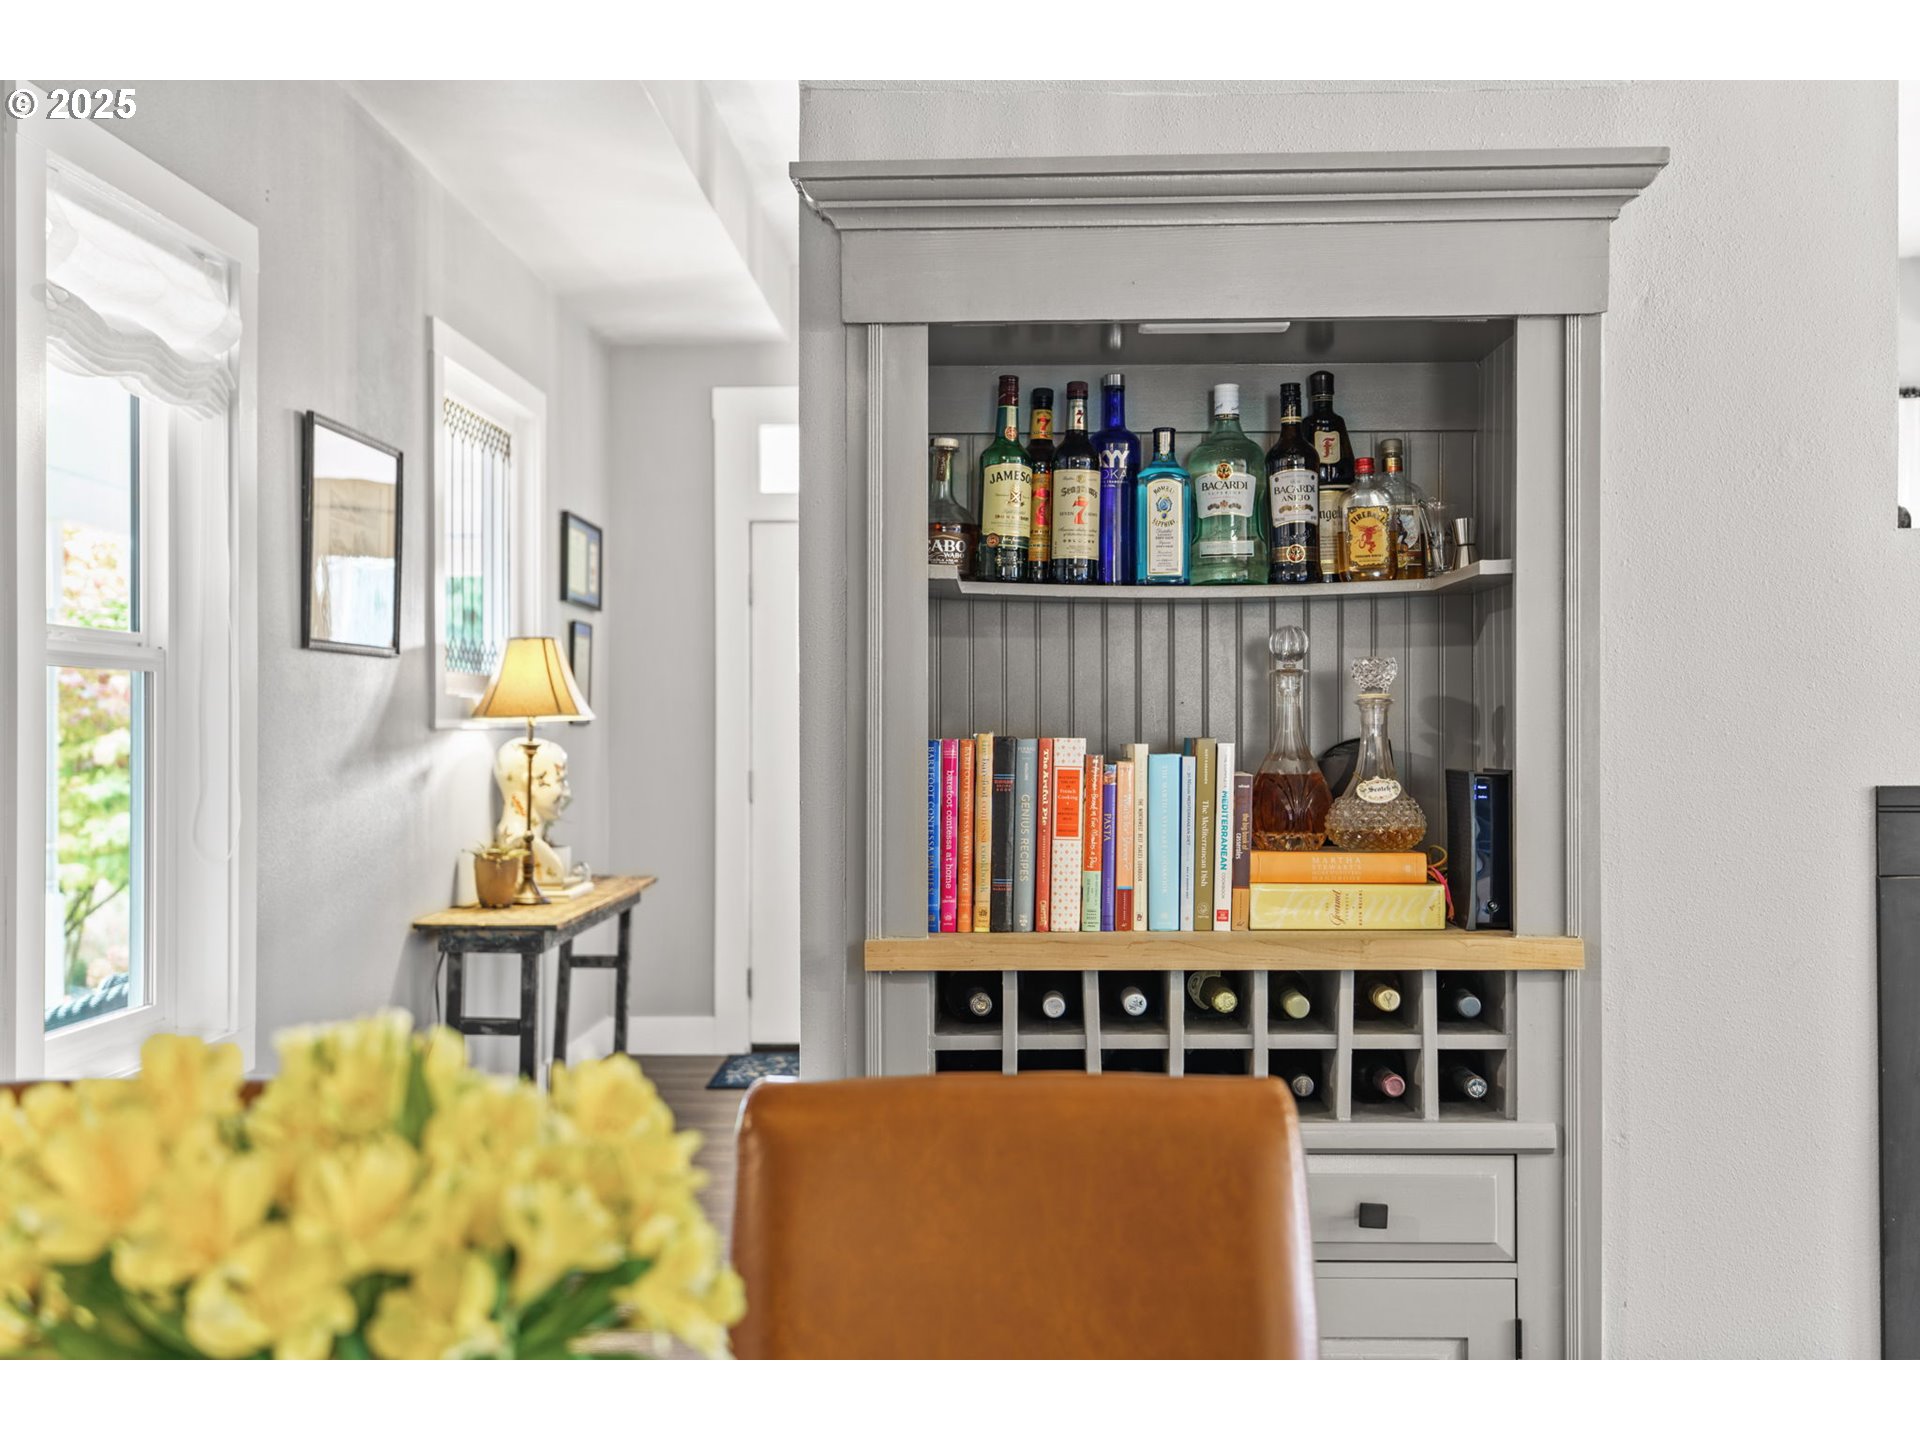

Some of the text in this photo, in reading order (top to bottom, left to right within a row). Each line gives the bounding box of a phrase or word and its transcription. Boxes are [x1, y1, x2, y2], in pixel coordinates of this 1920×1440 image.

[1099, 449, 1130, 468] KYY
[989, 469, 1032, 484] JAMESO
[1201, 480, 1248, 491] BACARDI
[1274, 484, 1316, 495] BACARDI
[1281, 493, 1311, 502] AÑEJO
[928, 746, 936, 798] BAREFOOT
[946, 770, 955, 808] barefoot
[928, 801, 936, 851] CONTESSA
[945, 810, 954, 850] contessa
[1019, 794, 1031, 882] GENIUS RECIPES
[1103, 813, 1112, 842] PASTA
[1220, 790, 1229, 871] MEDITERRANEAN
[1240, 822, 1250, 831] big
[1242, 831, 1250, 844] book
[1200, 800, 1210, 887] The Mediterranean Dish
[1235, 832, 1243, 860] casseroles
[945, 852, 953, 862] at
[1312, 856, 1361, 864] MARTHA
[945, 863, 953, 889] home
